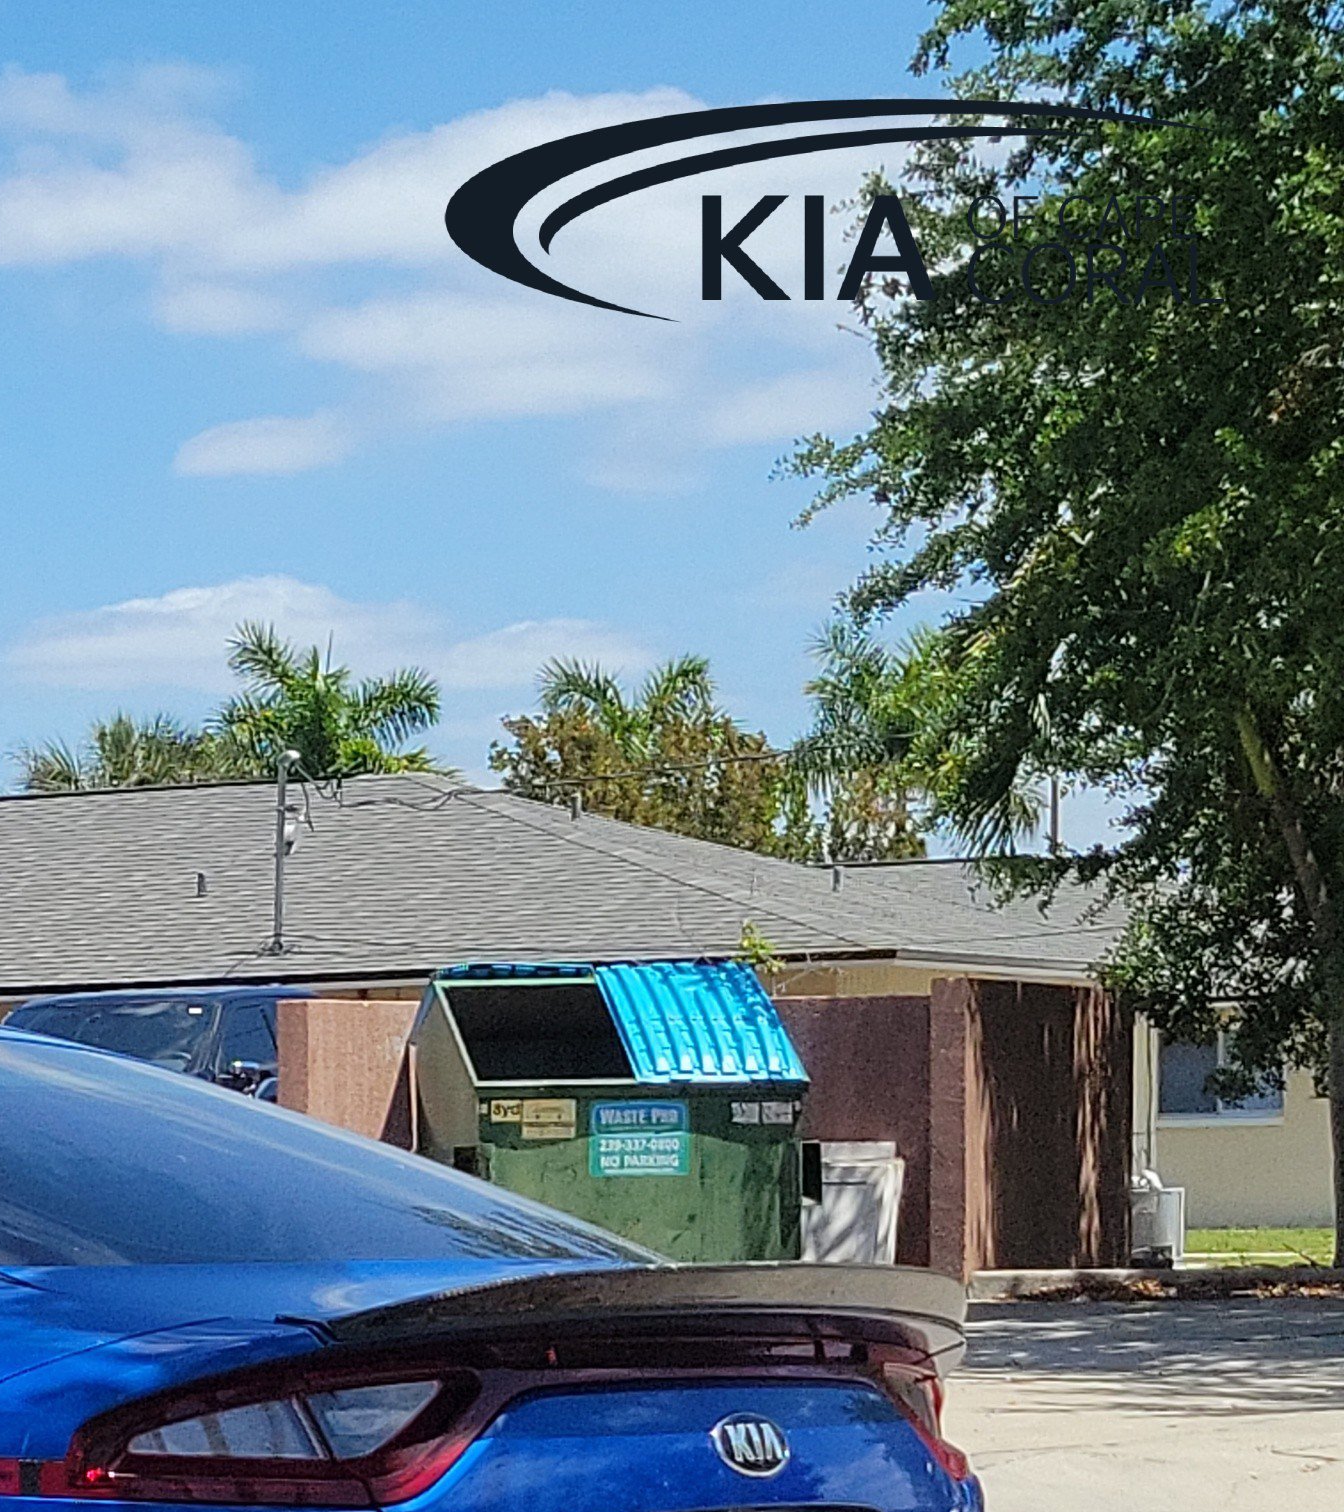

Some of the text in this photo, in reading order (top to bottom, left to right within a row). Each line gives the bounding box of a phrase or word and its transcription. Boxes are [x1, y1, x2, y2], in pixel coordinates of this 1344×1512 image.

[599, 1108, 646, 1124] WASTE
[600, 1154, 679, 1169] NO PARKING
[723, 1422, 784, 1462] KIA
